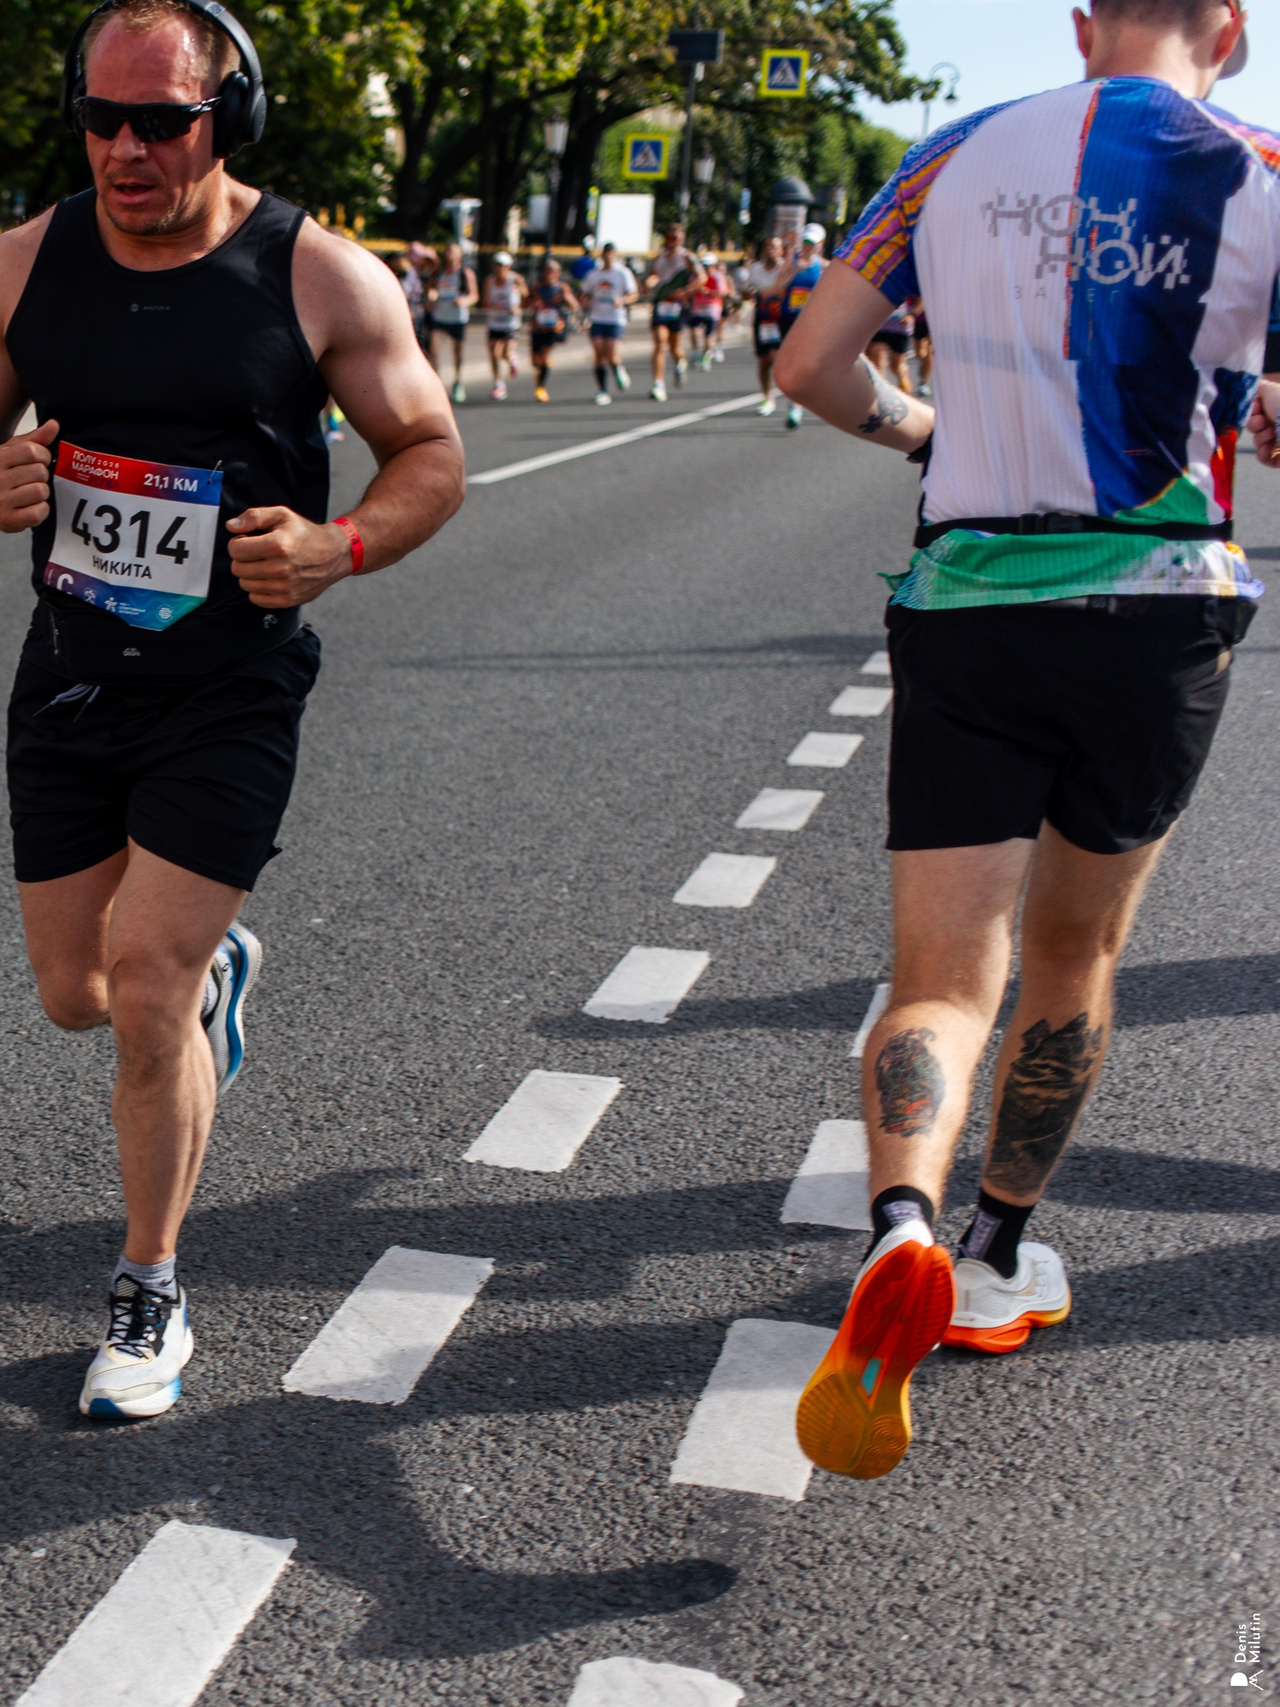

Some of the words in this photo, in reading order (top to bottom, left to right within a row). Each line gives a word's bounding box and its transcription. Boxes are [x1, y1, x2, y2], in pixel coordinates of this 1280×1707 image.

[72, 451, 96, 465] ПОЛУ
[71, 461, 119, 480] МАРАФОН
[143, 473, 169, 489] 21,1
[173, 477, 199, 492] КМ
[71, 498, 190, 565] 4314
[92, 555, 152, 580] НИКИТА
